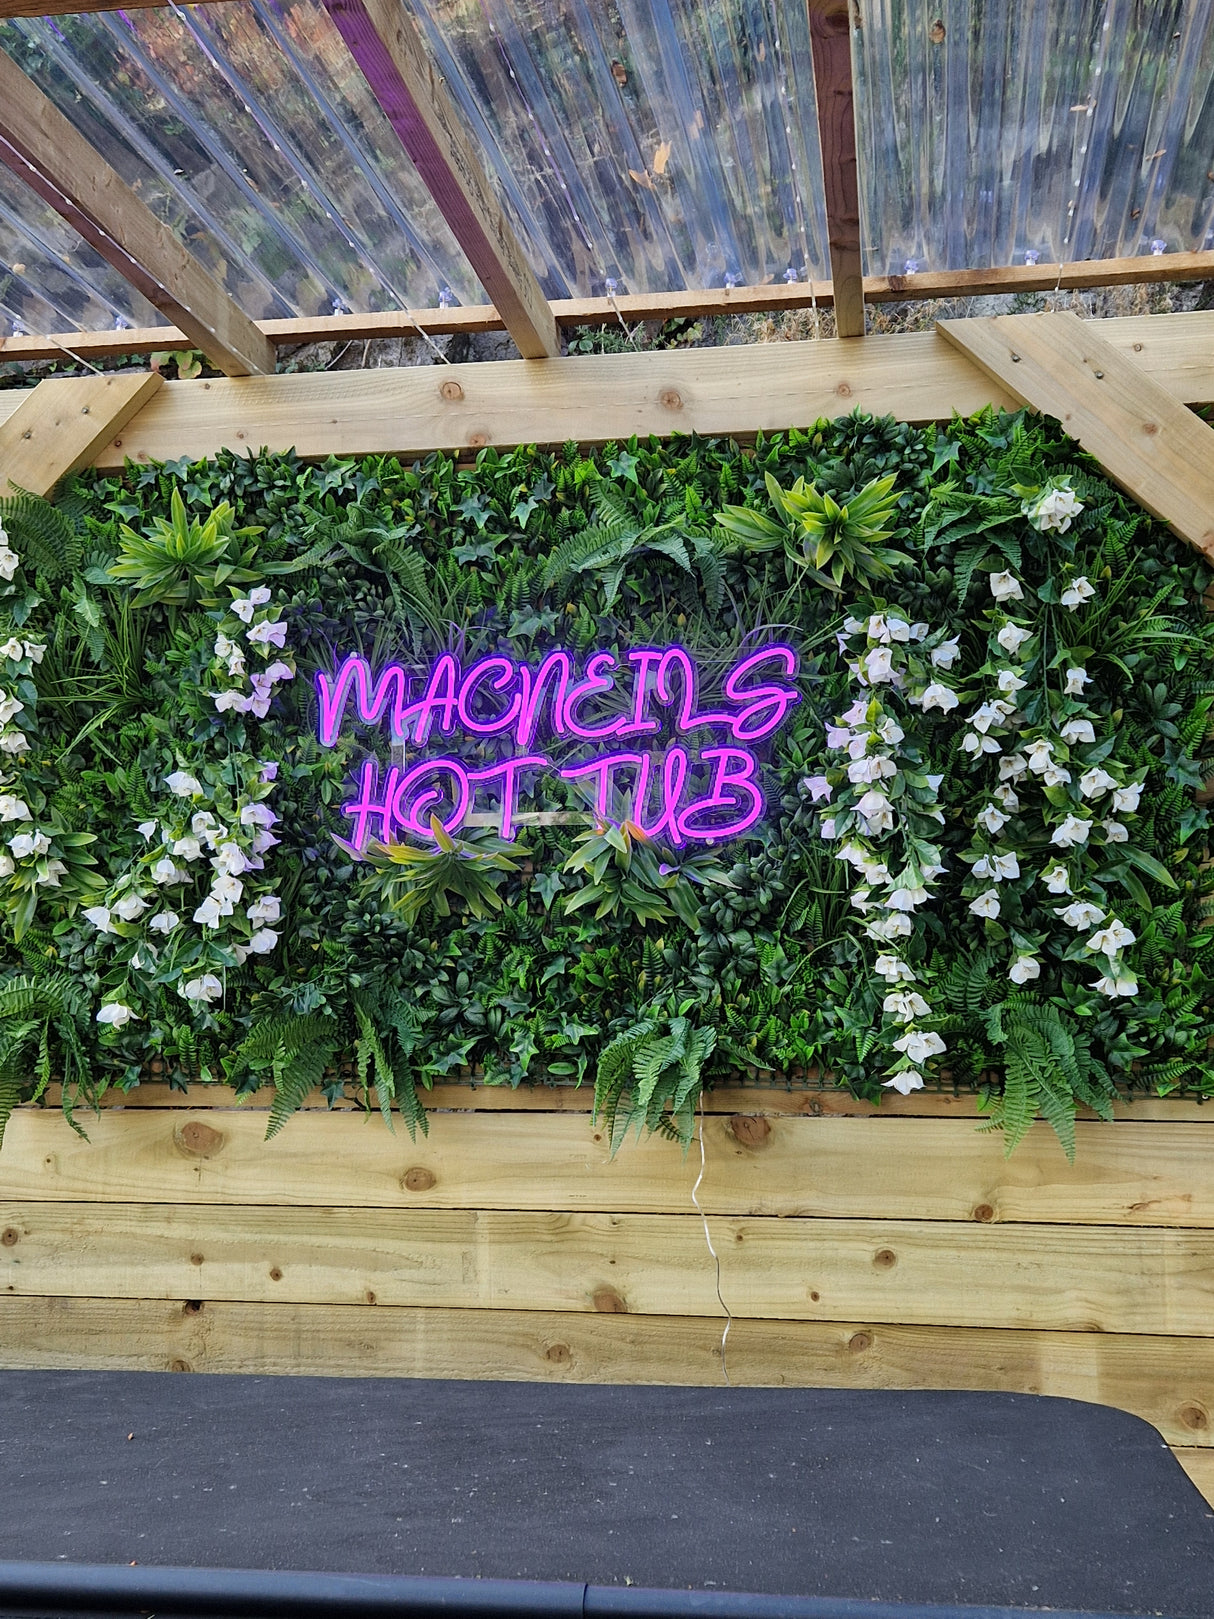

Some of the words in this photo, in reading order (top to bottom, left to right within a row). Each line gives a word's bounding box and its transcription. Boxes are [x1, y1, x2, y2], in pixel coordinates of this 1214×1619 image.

[317, 645, 800, 745] MACNEILS
[343, 755, 549, 851] HOT
[559, 747, 764, 844] TUB
